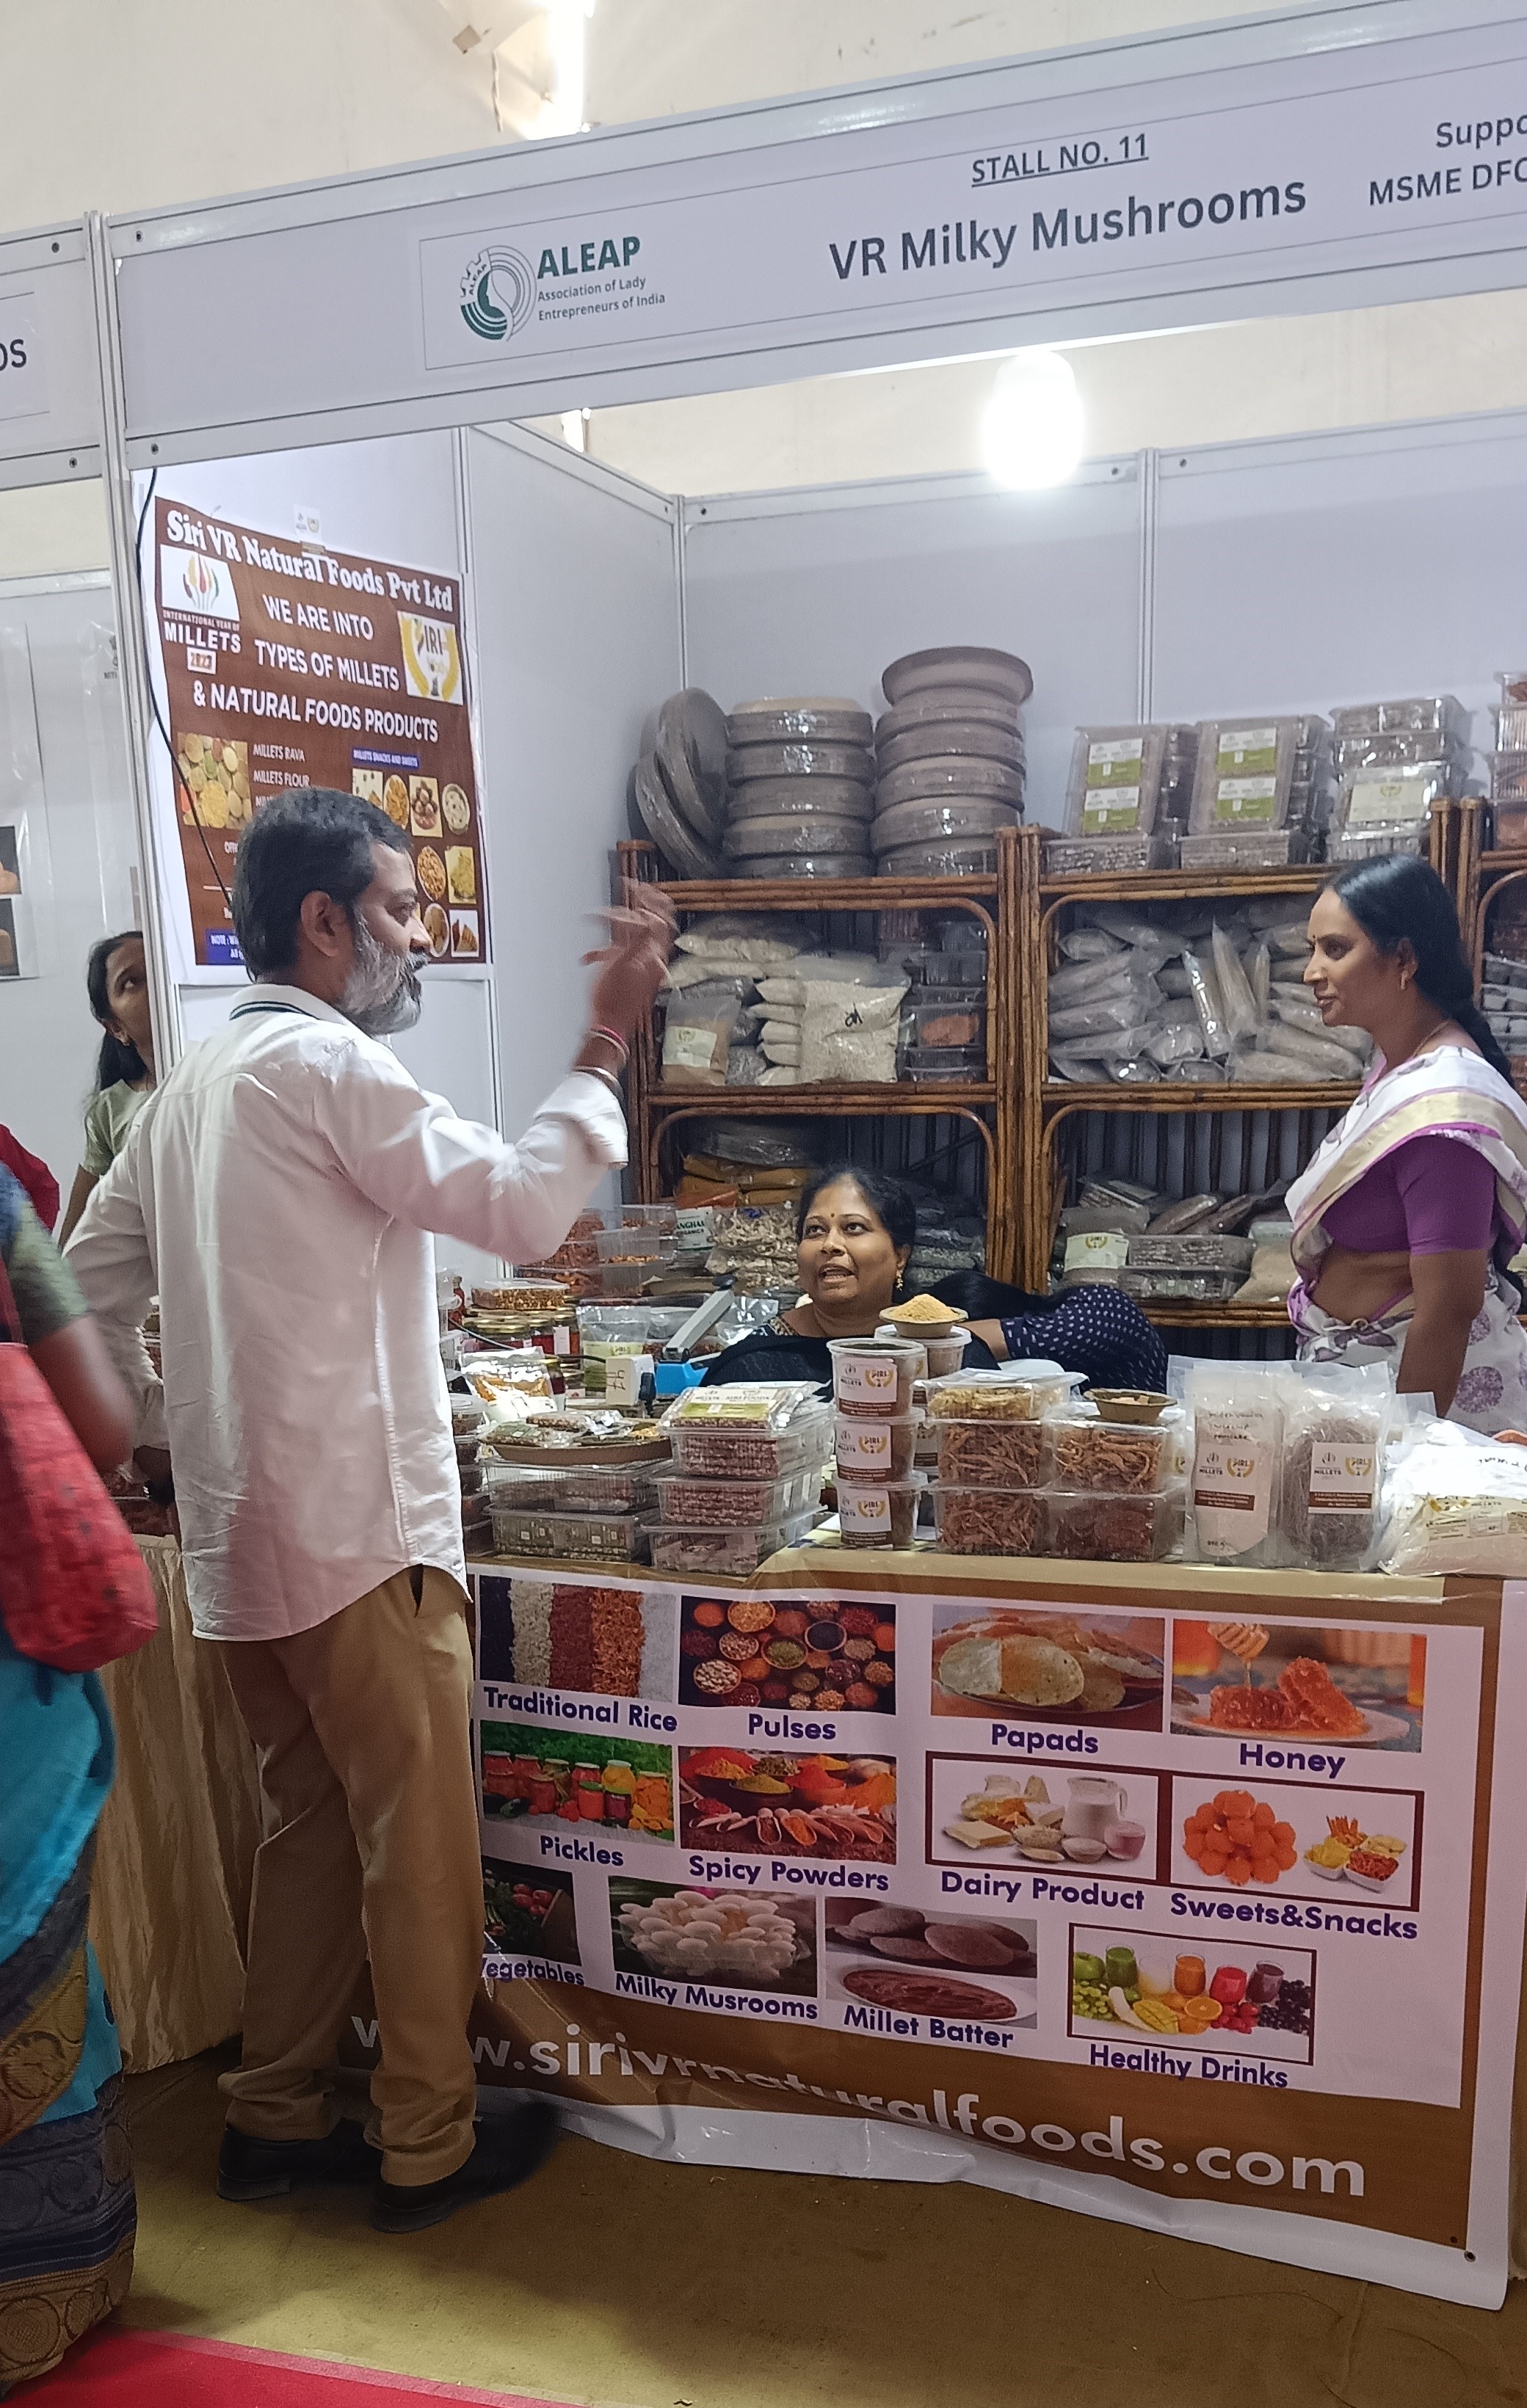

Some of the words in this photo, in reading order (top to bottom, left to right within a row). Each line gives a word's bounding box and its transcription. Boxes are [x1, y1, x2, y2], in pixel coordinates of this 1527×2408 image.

[971, 149, 1051, 183] STALL
[1060, 140, 1109, 170] NO.
[1120, 133, 1146, 159] 11
[1369, 167, 1462, 206] MSME
[829, 236, 887, 280] VR
[902, 219, 1018, 269] Milky
[1031, 179, 1307, 252] Mushrooms
[537, 236, 641, 280] ALEAP
[537, 283, 602, 302] Association
[604, 279, 617, 292] of
[619, 275, 647, 291] Lady
[538, 300, 620, 321] Entrepreneurs
[622, 296, 634, 309] of
[636, 293, 666, 308] India
[167, 509, 207, 551] Siri
[206, 524, 242, 563] VR
[242, 535, 324, 583] Natural
[325, 558, 385, 597] Foods
[386, 571, 421, 605] Pvt
[423, 579, 453, 613] Ltd
[163, 620, 242, 654] MILLETS
[262, 593, 294, 625] WE
[297, 602, 331, 633] ARE
[332, 610, 374, 641] INTO
[254, 639, 308, 672] TYPES
[310, 652, 334, 678] OF
[336, 656, 400, 691] MILLETS
[193, 680, 206, 707] &
[211, 683, 302, 722] NATURAL
[305, 697, 362, 731] FOODS
[364, 708, 439, 743] PRODUCTS
[253, 743, 284, 761] MILLETS
[285, 746, 306, 763] RAVA
[253, 770, 284, 786] MILLETS
[284, 772, 311, 788] FLOUR
[483, 1686, 619, 1724] Traditional
[628, 1703, 678, 1732] Rice
[747, 1713, 837, 1740] Pulses
[990, 1723, 1099, 1756] Papads
[1238, 1742, 1346, 1780] Honey
[540, 1835, 625, 1867] Pickles
[688, 1855, 761, 1885] Spicy
[771, 1860, 890, 1891] Powders
[940, 1871, 1023, 1903] Dairy
[1031, 1876, 1145, 1910] Product
[1169, 1892, 1419, 1940] Sweets&Snacks
[614, 1972, 678, 2006] Milky
[685, 1989, 819, 2020] Musrooms
[844, 2004, 920, 2037] Millet
[929, 2017, 1014, 2049] Batter
[1089, 2043, 1192, 2081] Healthy
[1200, 2056, 1289, 2088] Drinks
[351, 2015, 1365, 2197] ww.sirivrnaturalfoods.com
